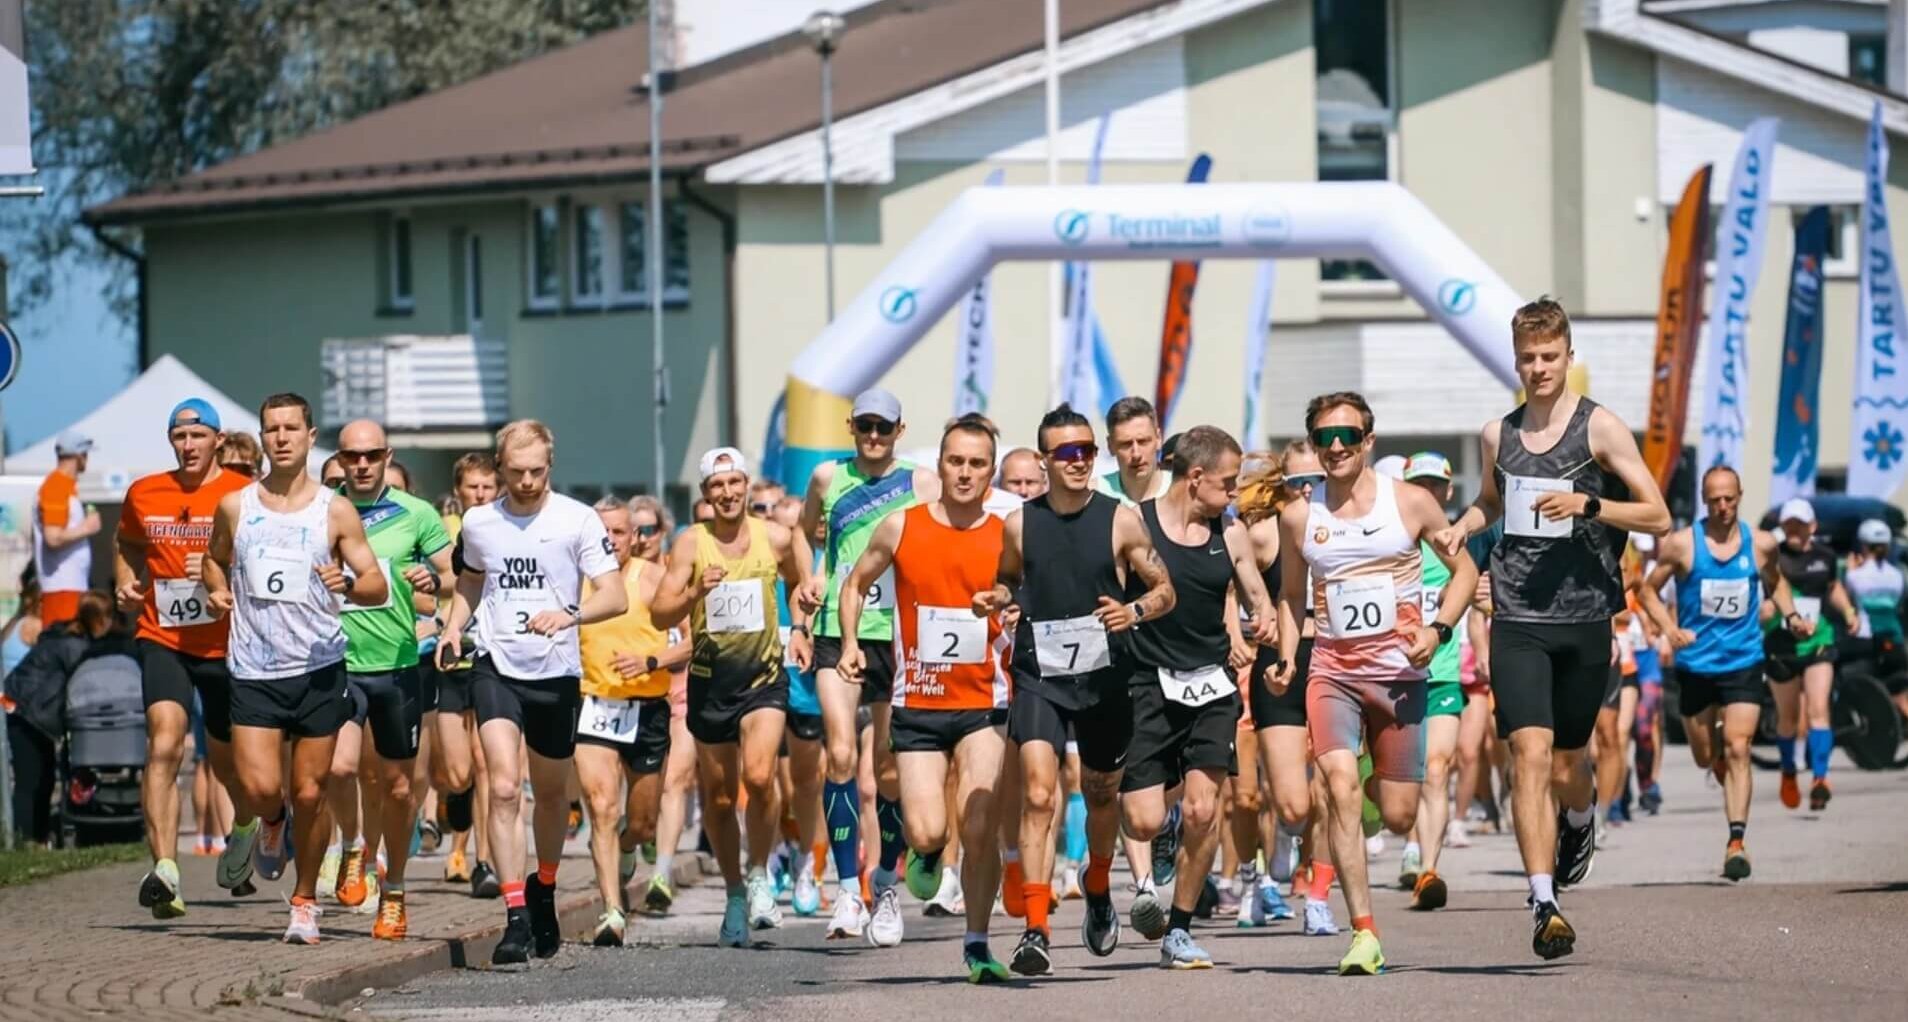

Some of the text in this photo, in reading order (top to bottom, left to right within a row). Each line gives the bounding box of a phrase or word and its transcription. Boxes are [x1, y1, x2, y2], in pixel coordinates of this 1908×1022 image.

[1732, 148, 1761, 257] VALD
[1107, 213, 1222, 237] Terminal
[1869, 251, 1896, 380] TARTU
[503, 557, 537, 574] YOU
[266, 570, 285, 594] 6
[498, 573, 545, 590] CAN'T
[711, 593, 753, 617] 201
[867, 583, 882, 606] 9
[1424, 591, 1438, 613] 5
[1711, 596, 1740, 613] 75
[169, 598, 202, 621] 49
[1342, 602, 1382, 632] 20
[515, 611, 530, 635] 3
[941, 632, 960, 658] 2
[1062, 642, 1080, 670] 7
[922, 683, 945, 697] Welt
[1181, 682, 1218, 702] 44
[592, 715, 621, 734] 81
